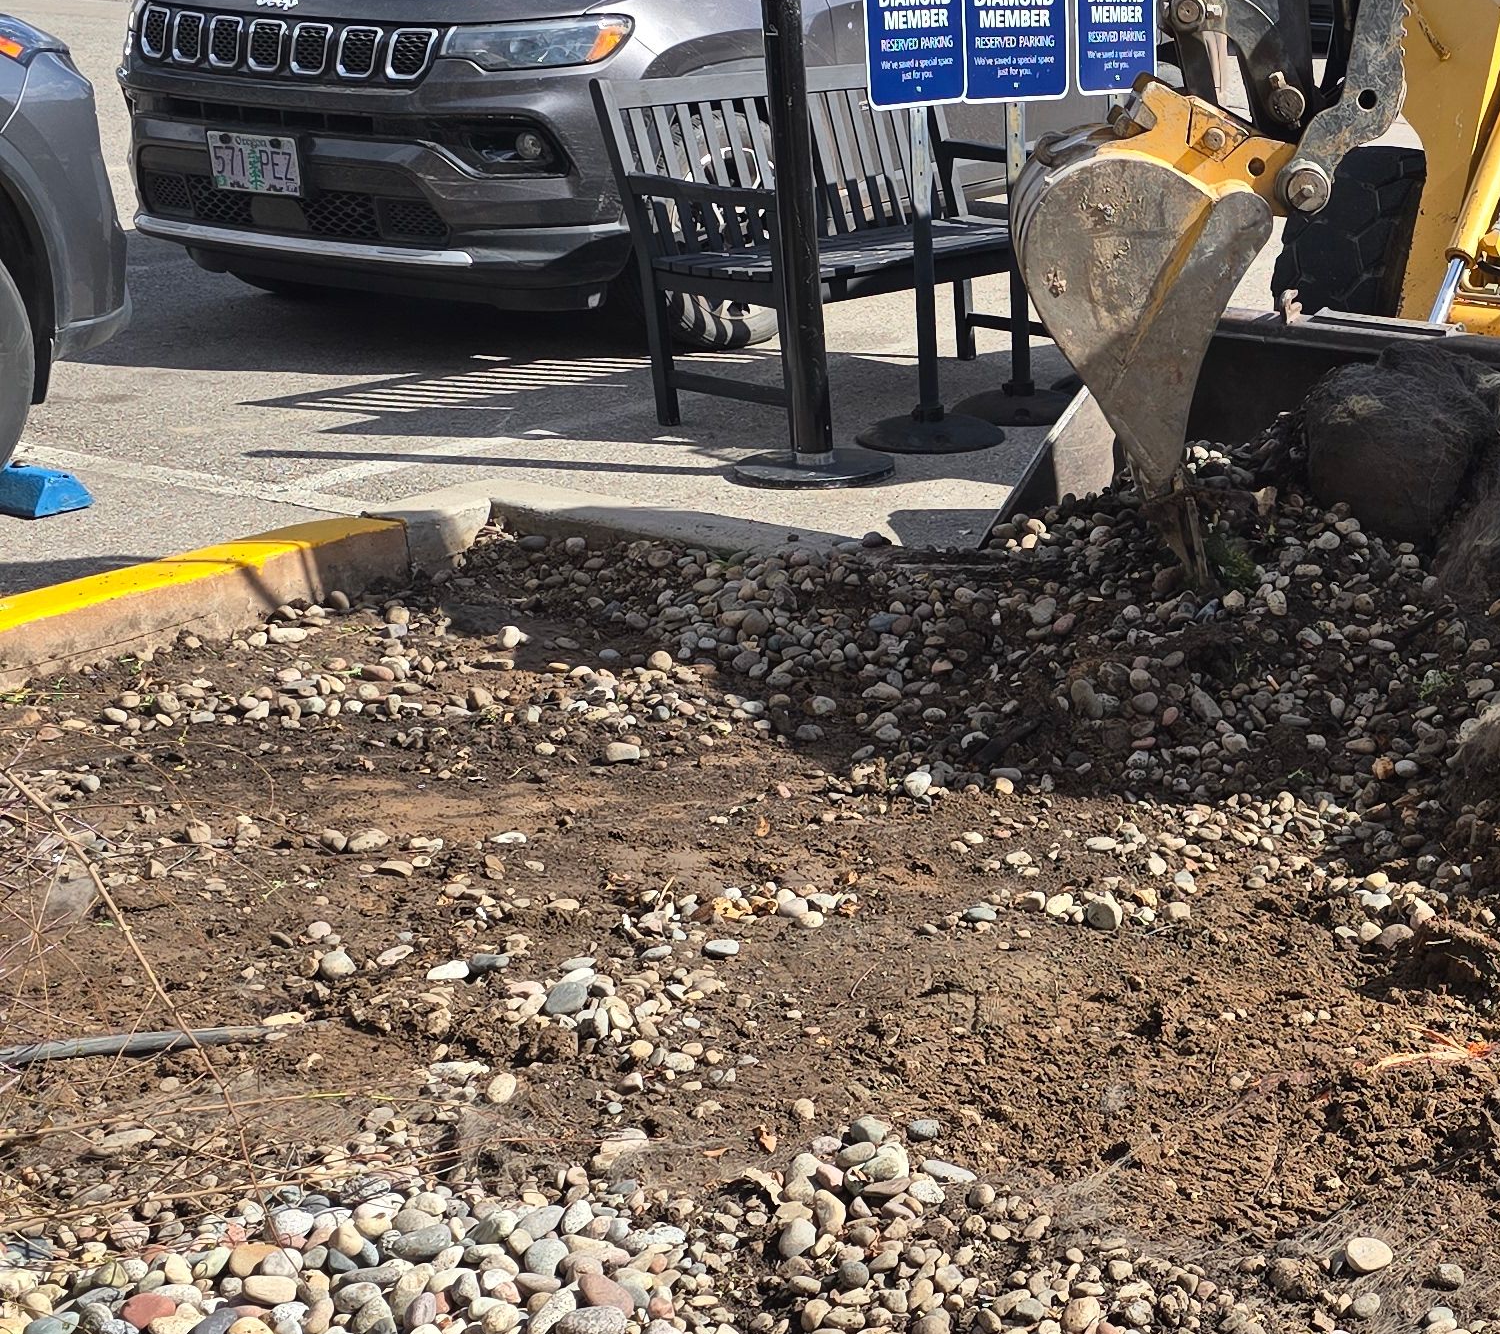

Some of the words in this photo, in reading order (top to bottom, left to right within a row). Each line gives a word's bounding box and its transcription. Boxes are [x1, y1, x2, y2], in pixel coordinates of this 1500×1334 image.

[883, 8, 949, 30] MEMBER
[979, 9, 1051, 28] MEMBER
[1091, 5, 1143, 23] MEMBER
[975, 36, 1017, 48] RESERVED
[1018, 35, 1055, 47] PARKING
[1087, 31, 1119, 43] RESERVED
[1119, 30, 1146, 42] PARKING
[881, 38, 919, 52] RESERVED
[920, 35, 953, 49] PARKING
[919, 57, 938, 69] special
[974, 56, 993, 66] We've
[1017, 55, 1037, 66] special
[1038, 55, 1055, 65] space
[902, 71, 913, 82] just
[913, 69, 922, 79] for
[997, 67, 1009, 78] just
[1009, 67, 1019, 75] for
[235, 136, 268, 148] Oregon
[213, 145, 246, 177] 571
[259, 149, 295, 182] PEZ
